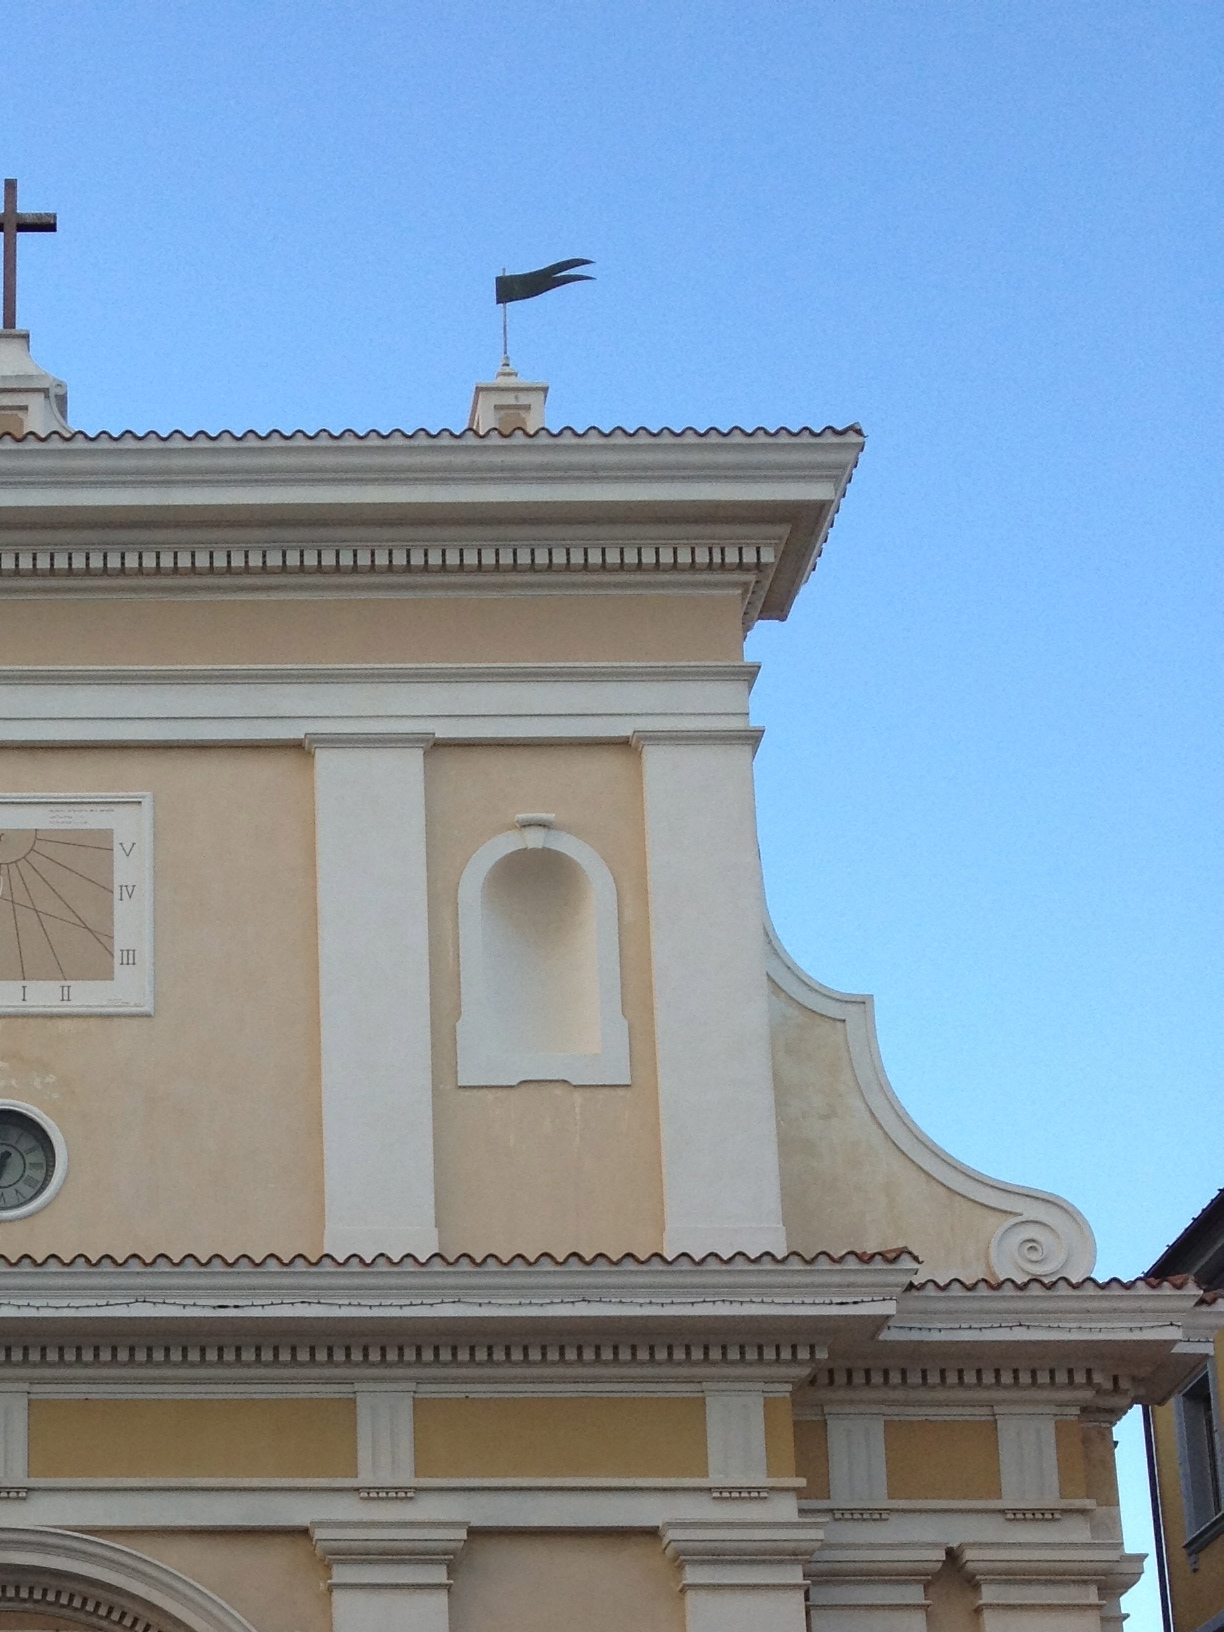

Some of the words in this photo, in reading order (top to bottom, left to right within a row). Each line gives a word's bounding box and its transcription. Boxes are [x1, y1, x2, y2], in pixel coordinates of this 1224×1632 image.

[119, 843, 136, 856] V
[119, 885, 136, 901] IV
[120, 949, 136, 965] III
[21, 986, 27, 1001] I
[60, 986, 71, 1001] II
